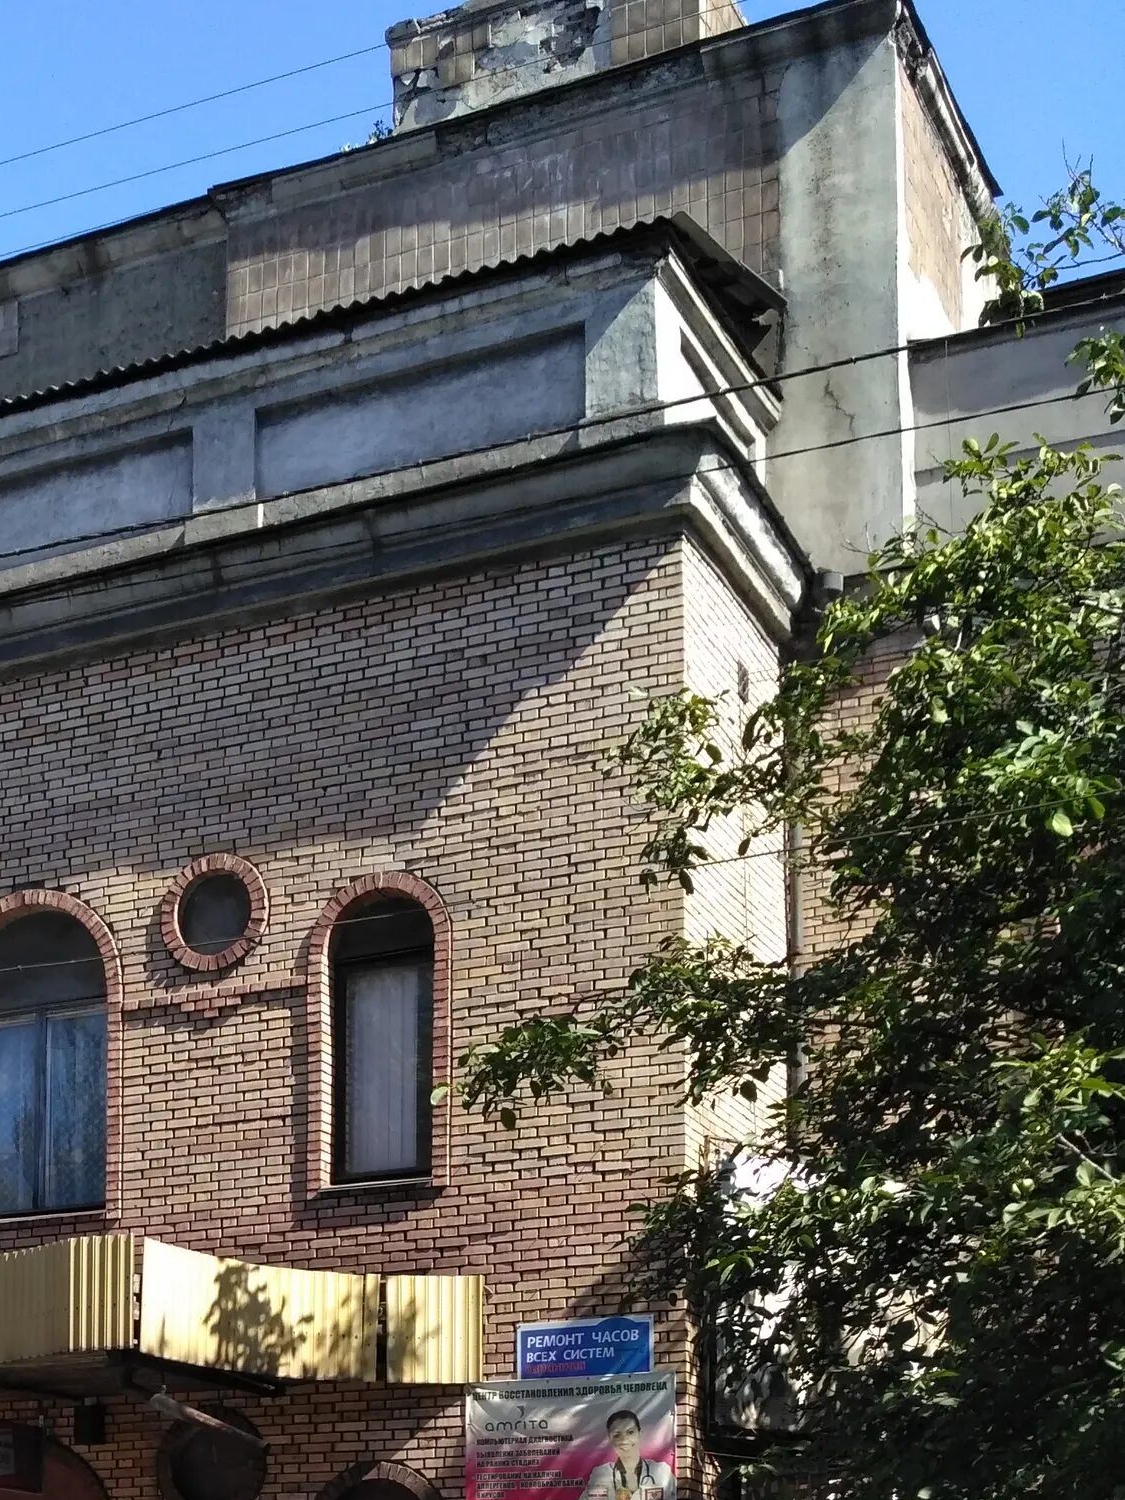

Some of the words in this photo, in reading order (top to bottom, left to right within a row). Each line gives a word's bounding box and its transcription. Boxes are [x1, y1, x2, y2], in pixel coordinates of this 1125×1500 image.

[527, 1333, 585, 1348] РЕМОНТ
[592, 1329, 640, 1344] ЧАСОВ
[526, 1351, 558, 1364] ВСЕХ
[563, 1346, 615, 1361] СИСТЕМ
[499, 1389, 575, 1400] ВОССТАНОВЛЕНИЯ
[576, 1385, 623, 1397] ЗДОРОВЬЯ
[624, 1381, 668, 1394] ЧЕЛОВЕКА
